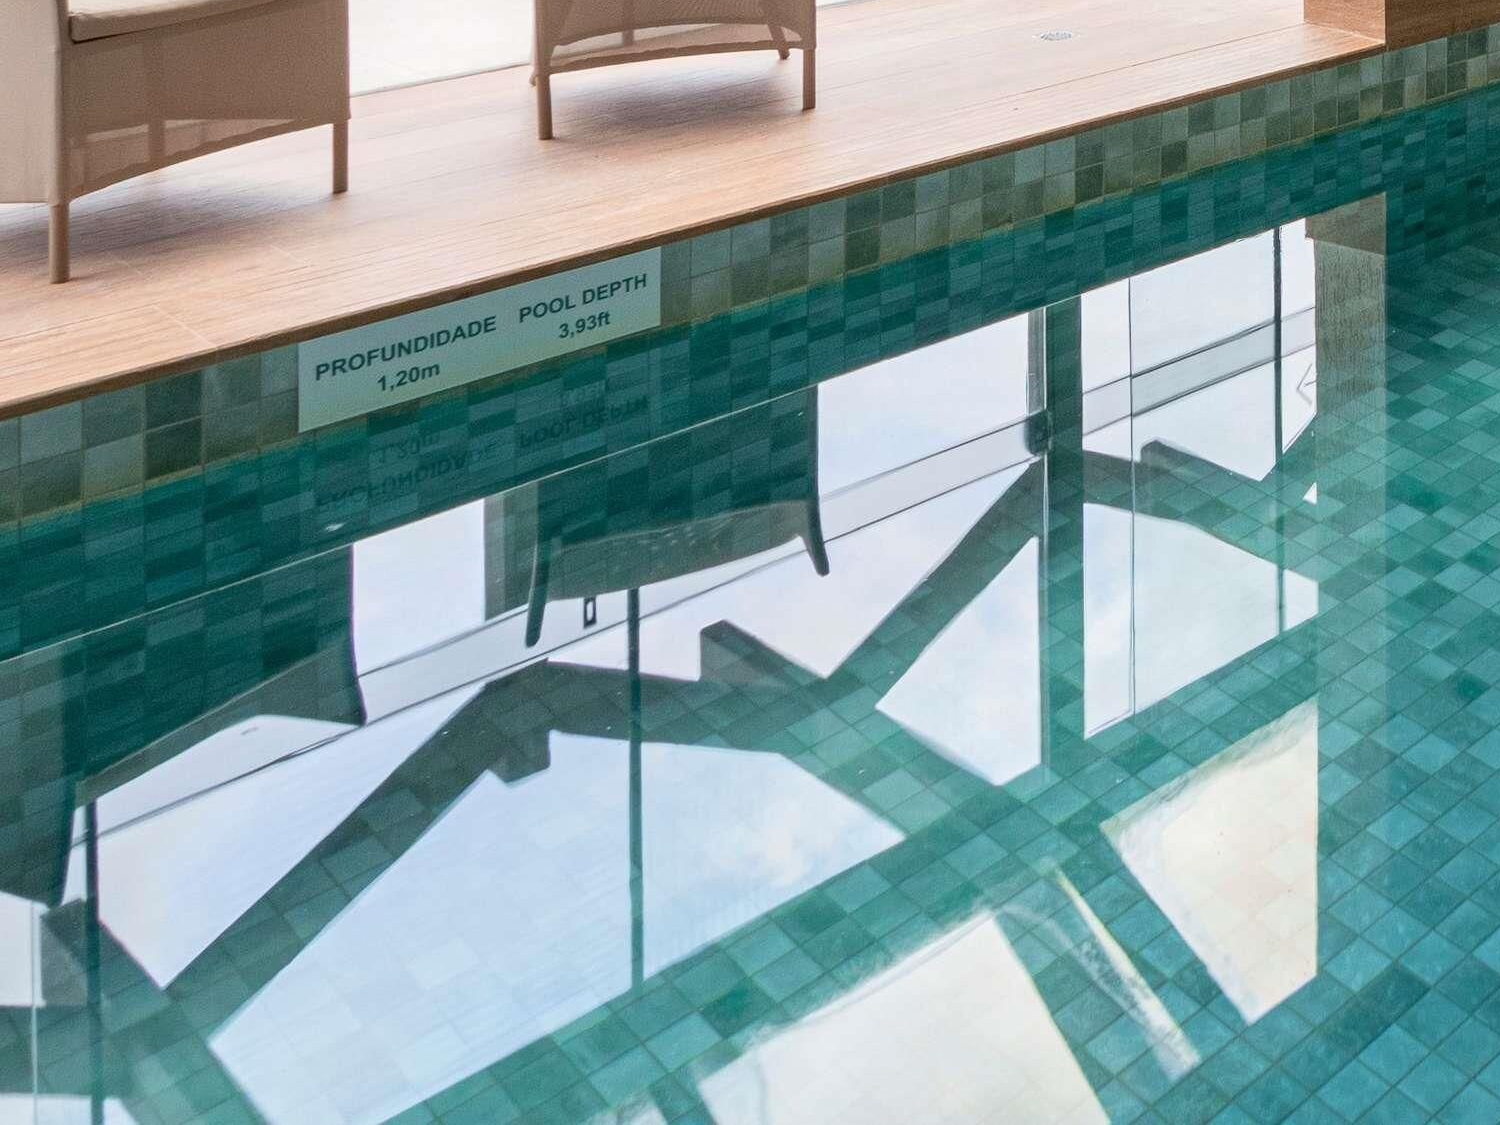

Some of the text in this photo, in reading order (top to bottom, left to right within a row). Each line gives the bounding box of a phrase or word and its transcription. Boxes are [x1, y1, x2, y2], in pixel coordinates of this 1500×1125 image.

[315, 273, 647, 380] PROFUNDIDADE POOL DEPTH
[378, 311, 611, 392] 1,20m 3,93ft
